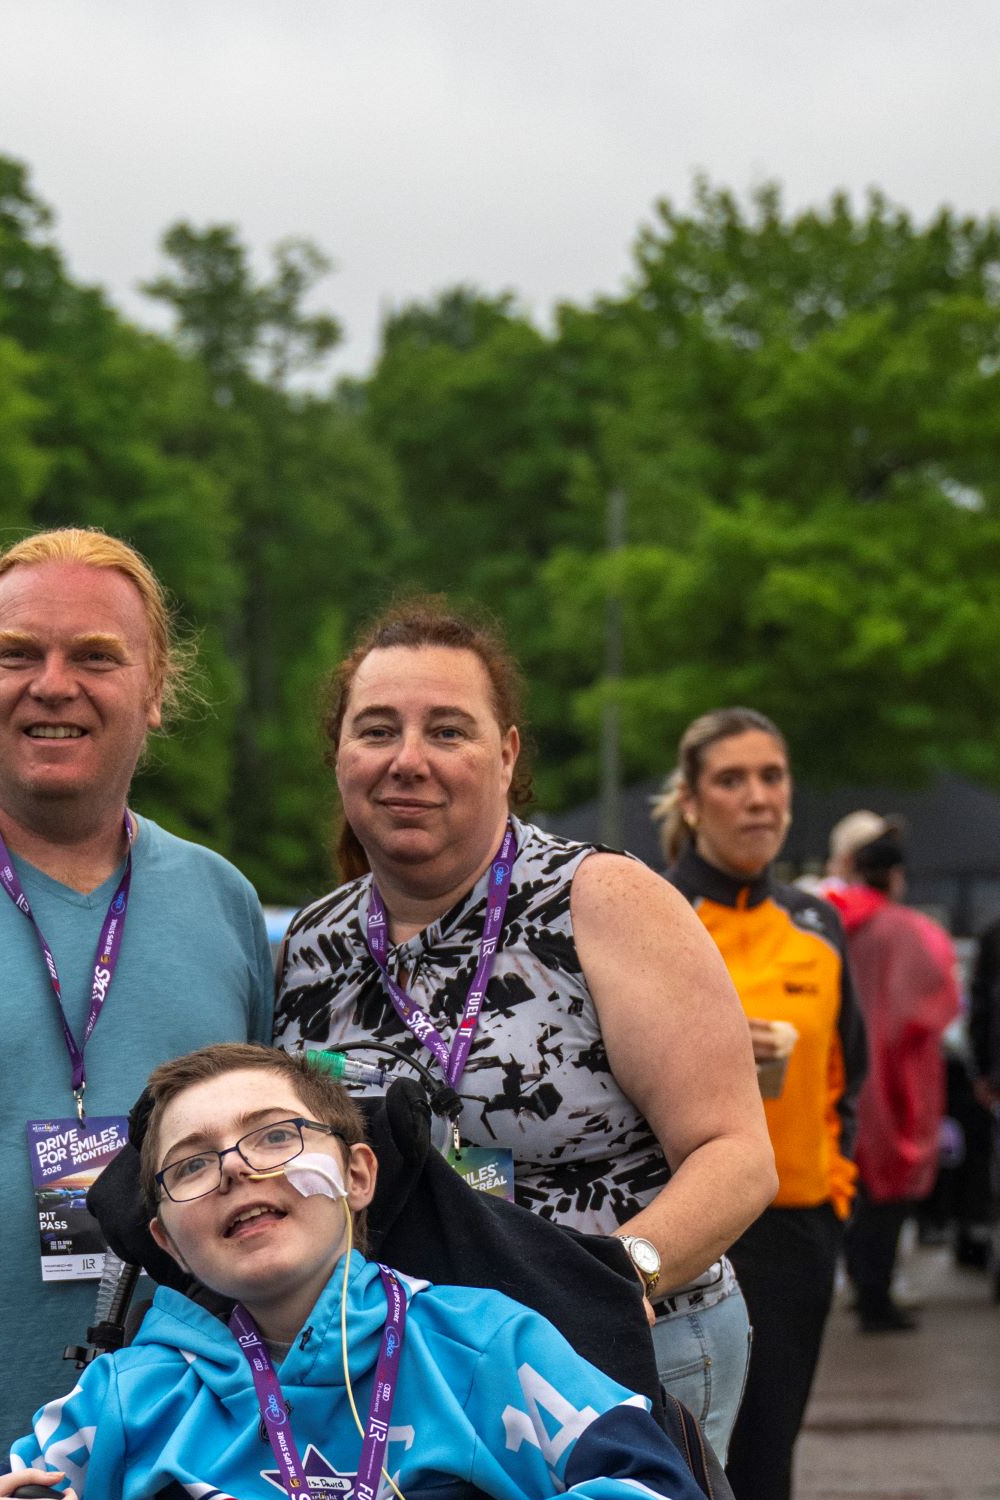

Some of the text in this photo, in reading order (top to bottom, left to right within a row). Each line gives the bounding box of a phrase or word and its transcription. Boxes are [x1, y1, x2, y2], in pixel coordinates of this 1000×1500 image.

[459, 991, 482, 1038] FUEL IT
[36, 1128, 79, 1155] DRIVE
[39, 1127, 118, 1168] FOR SMILES
[42, 1164, 62, 1176] 2026
[39, 1211, 56, 1221] PIT
[40, 1220, 68, 1230] PASS
[82, 1258, 96, 1270] JLR
[239, 1332, 262, 1348] JLR
[374, 1382, 384, 1413] St-Laurent
[369, 1416, 388, 1442] JLR
[276, 1431, 289, 1452] STORE
[287, 1465, 297, 1477] THE
